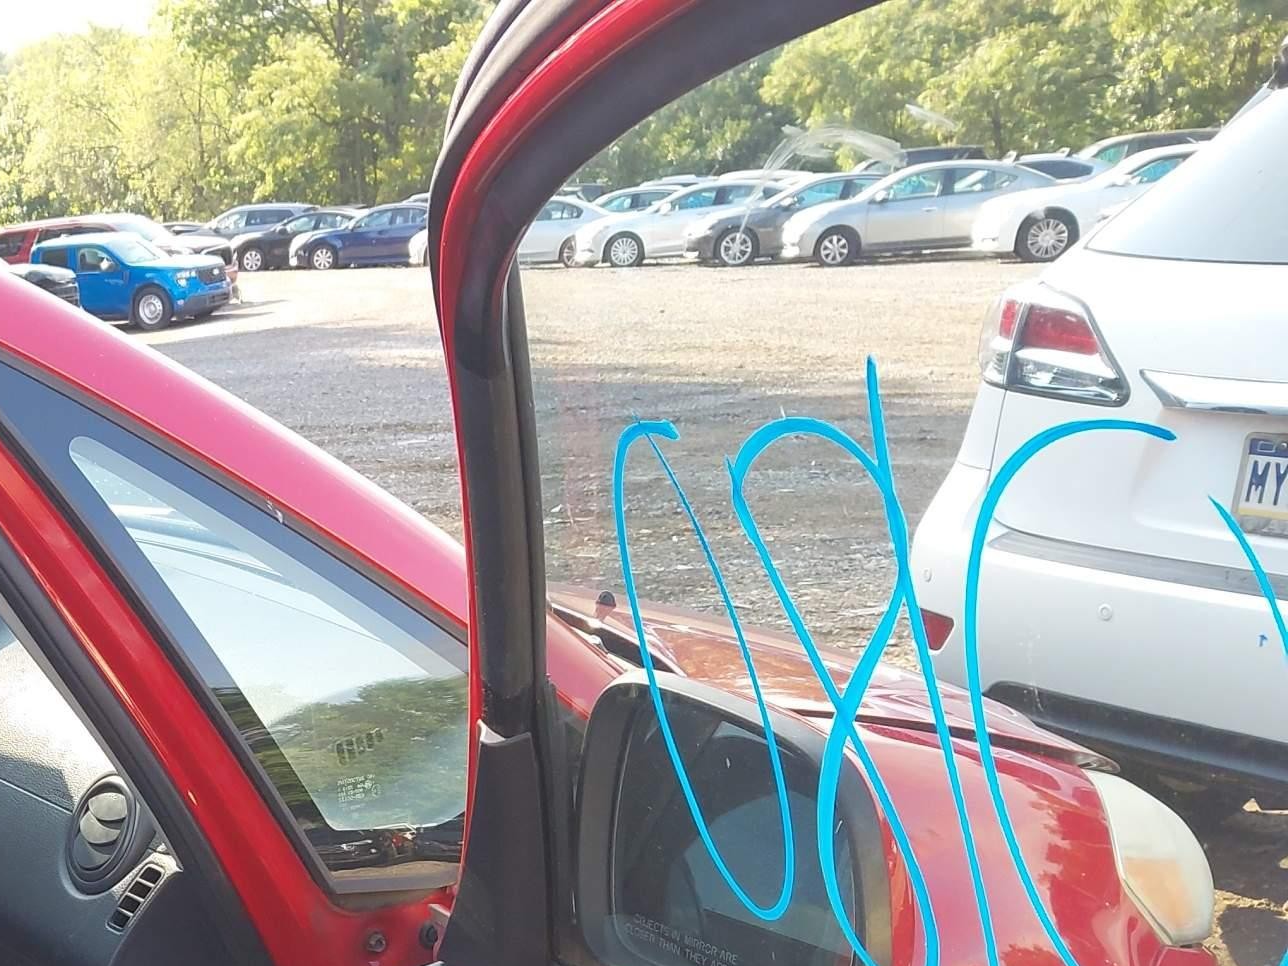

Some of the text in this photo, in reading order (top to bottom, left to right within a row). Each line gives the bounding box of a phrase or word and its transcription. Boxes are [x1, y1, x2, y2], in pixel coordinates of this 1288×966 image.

[658, 938, 681, 956] THAN
[685, 948, 708, 965] THEY
[684, 935, 718, 957] MIRROR
[719, 949, 739, 965] ARE
